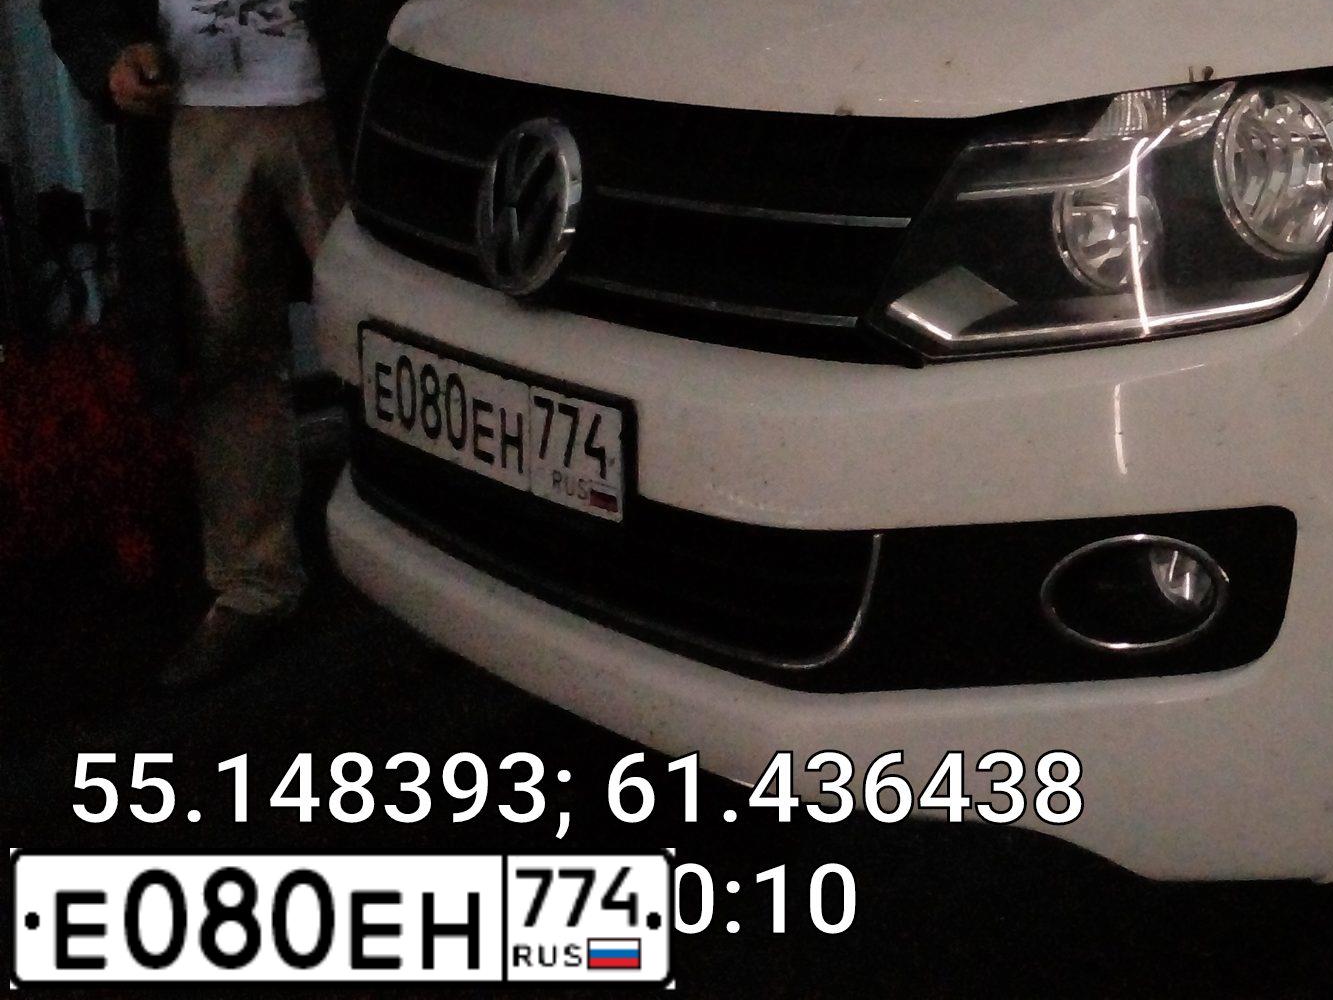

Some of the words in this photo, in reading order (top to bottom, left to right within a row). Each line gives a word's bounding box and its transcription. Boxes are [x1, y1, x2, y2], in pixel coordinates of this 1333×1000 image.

[374, 354, 525, 475] E080EH
[533, 395, 607, 480] 774
[552, 469, 589, 500] RUS
